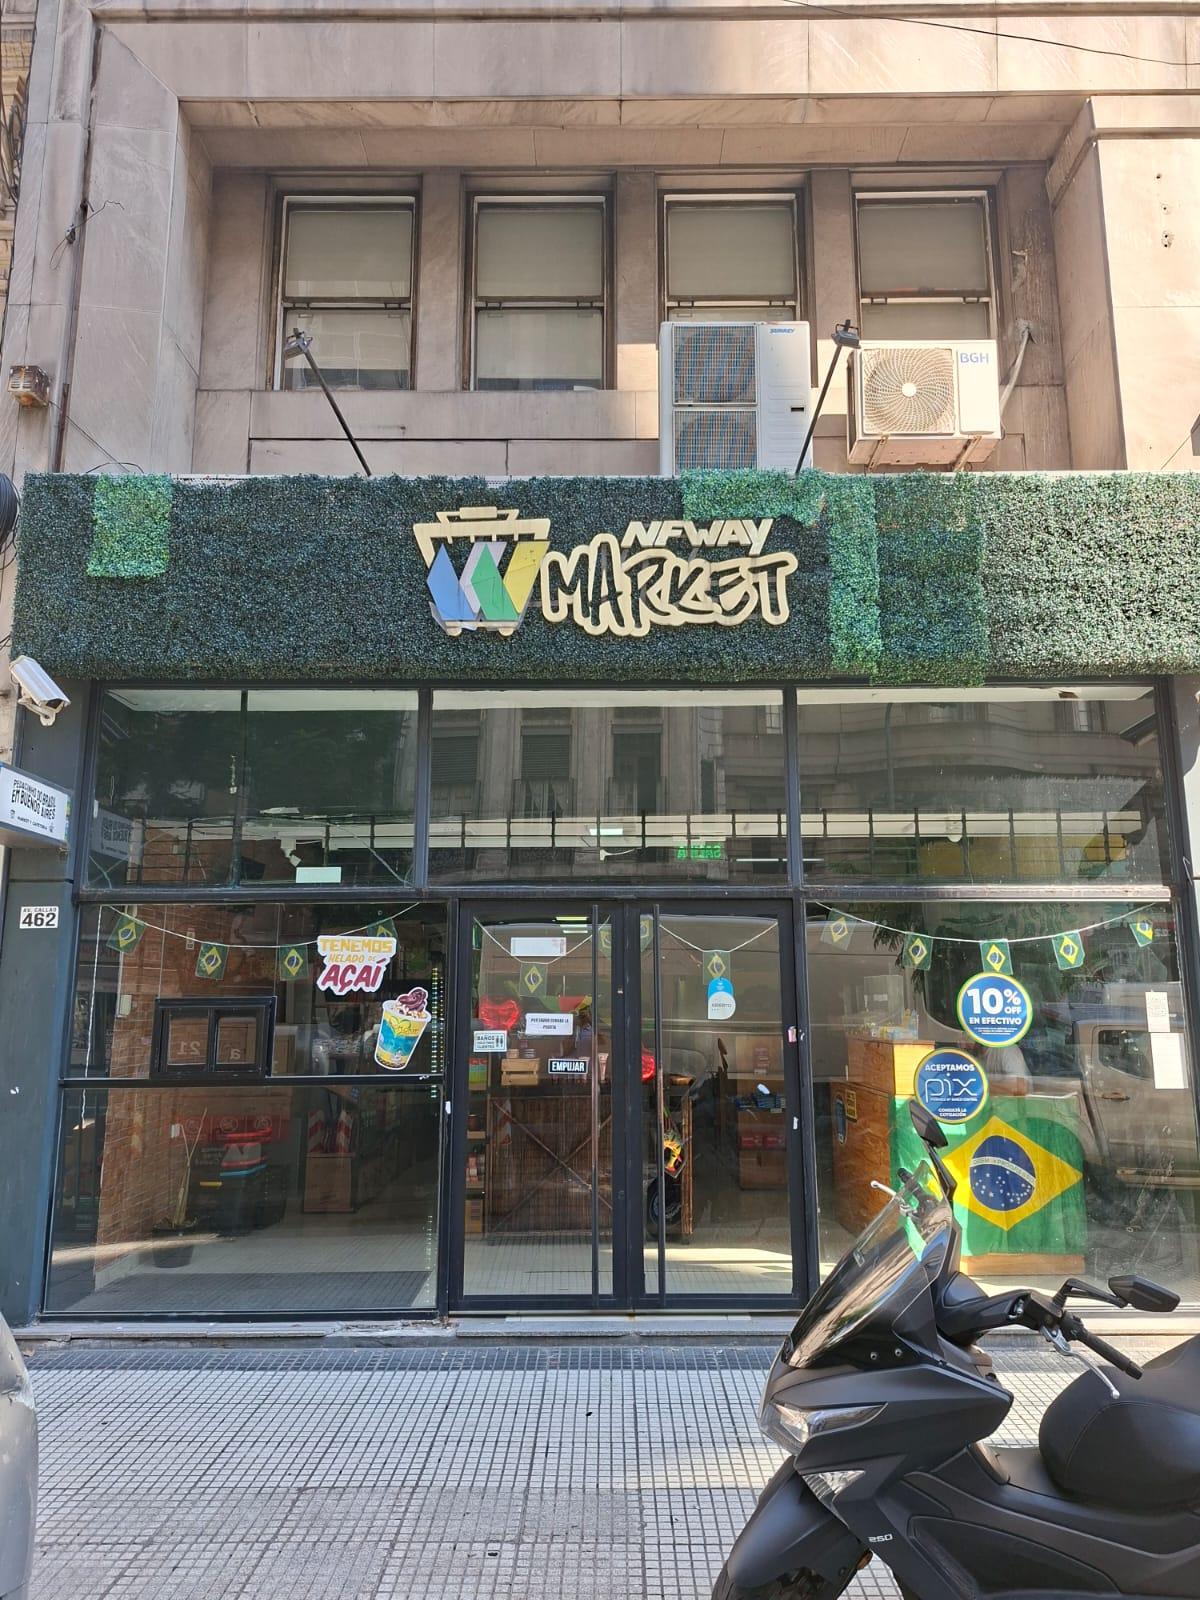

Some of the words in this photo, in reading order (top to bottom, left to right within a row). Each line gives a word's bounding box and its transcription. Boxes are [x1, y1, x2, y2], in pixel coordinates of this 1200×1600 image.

[960, 352, 989, 364] BGH
[542, 534, 798, 637] MARKET
[11, 789, 21, 803] EM
[20, 790, 41, 815] BUENOS
[41, 805, 56, 820] AIRES
[22, 912, 56, 927] 462
[320, 938, 393, 953] TENEMOS
[327, 954, 365, 963] HELADO
[321, 958, 387, 992] AÇAÍ
[1004, 1006, 1022, 1014] OFF
[969, 1017, 980, 1025] EN
[981, 1017, 1022, 1025] EFECTIVO
[551, 1061, 585, 1072] EMPUJAR
[925, 1063, 975, 1072] ACEPTAMOS
[925, 1073, 978, 1103] pix
[867, 1533, 893, 1543] 250
